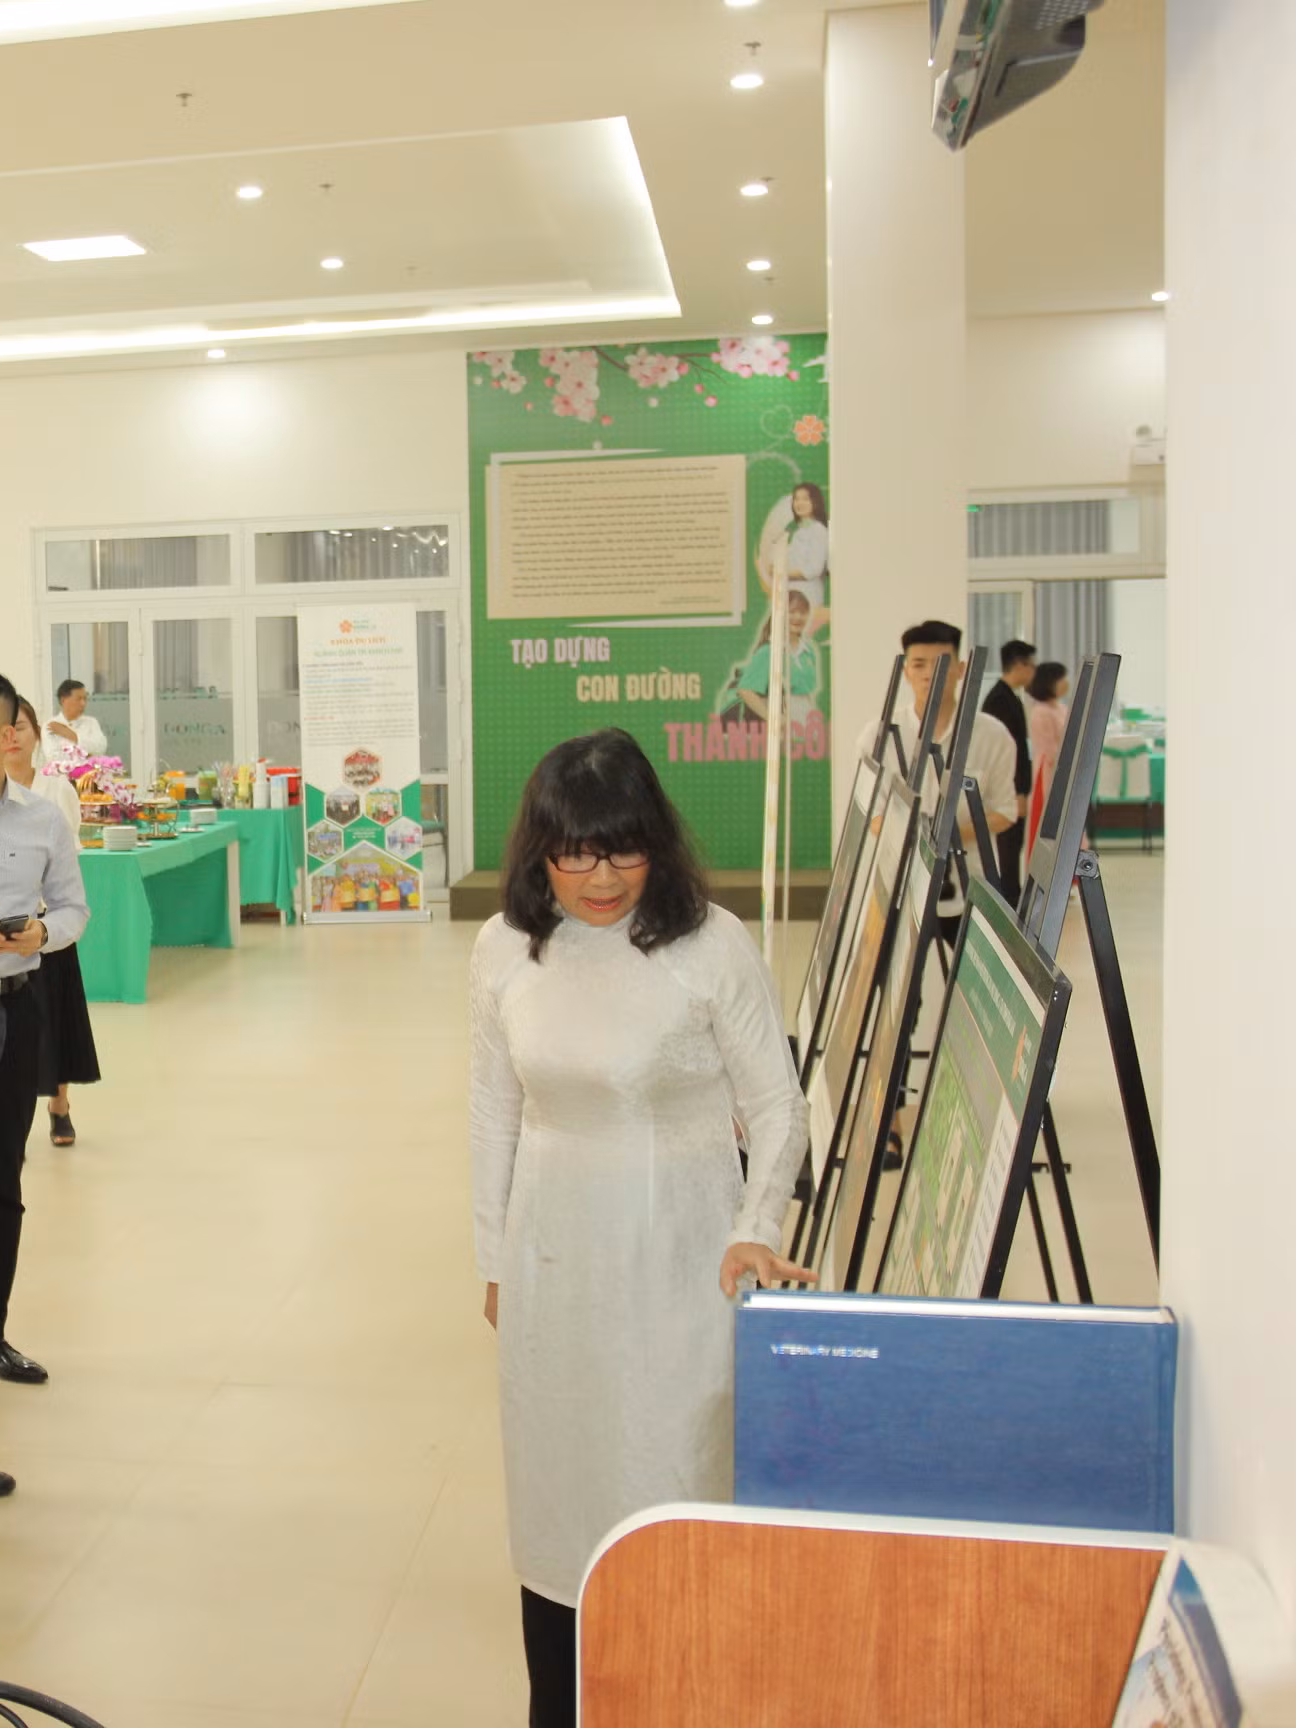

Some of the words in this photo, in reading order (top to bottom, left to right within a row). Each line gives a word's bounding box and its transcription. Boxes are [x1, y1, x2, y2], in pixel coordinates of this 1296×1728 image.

[510, 638, 548, 669] TẠO
[554, 636, 611, 668] DỰNG
[576, 674, 620, 702] CON
[625, 666, 701, 701] ĐƯỜNG
